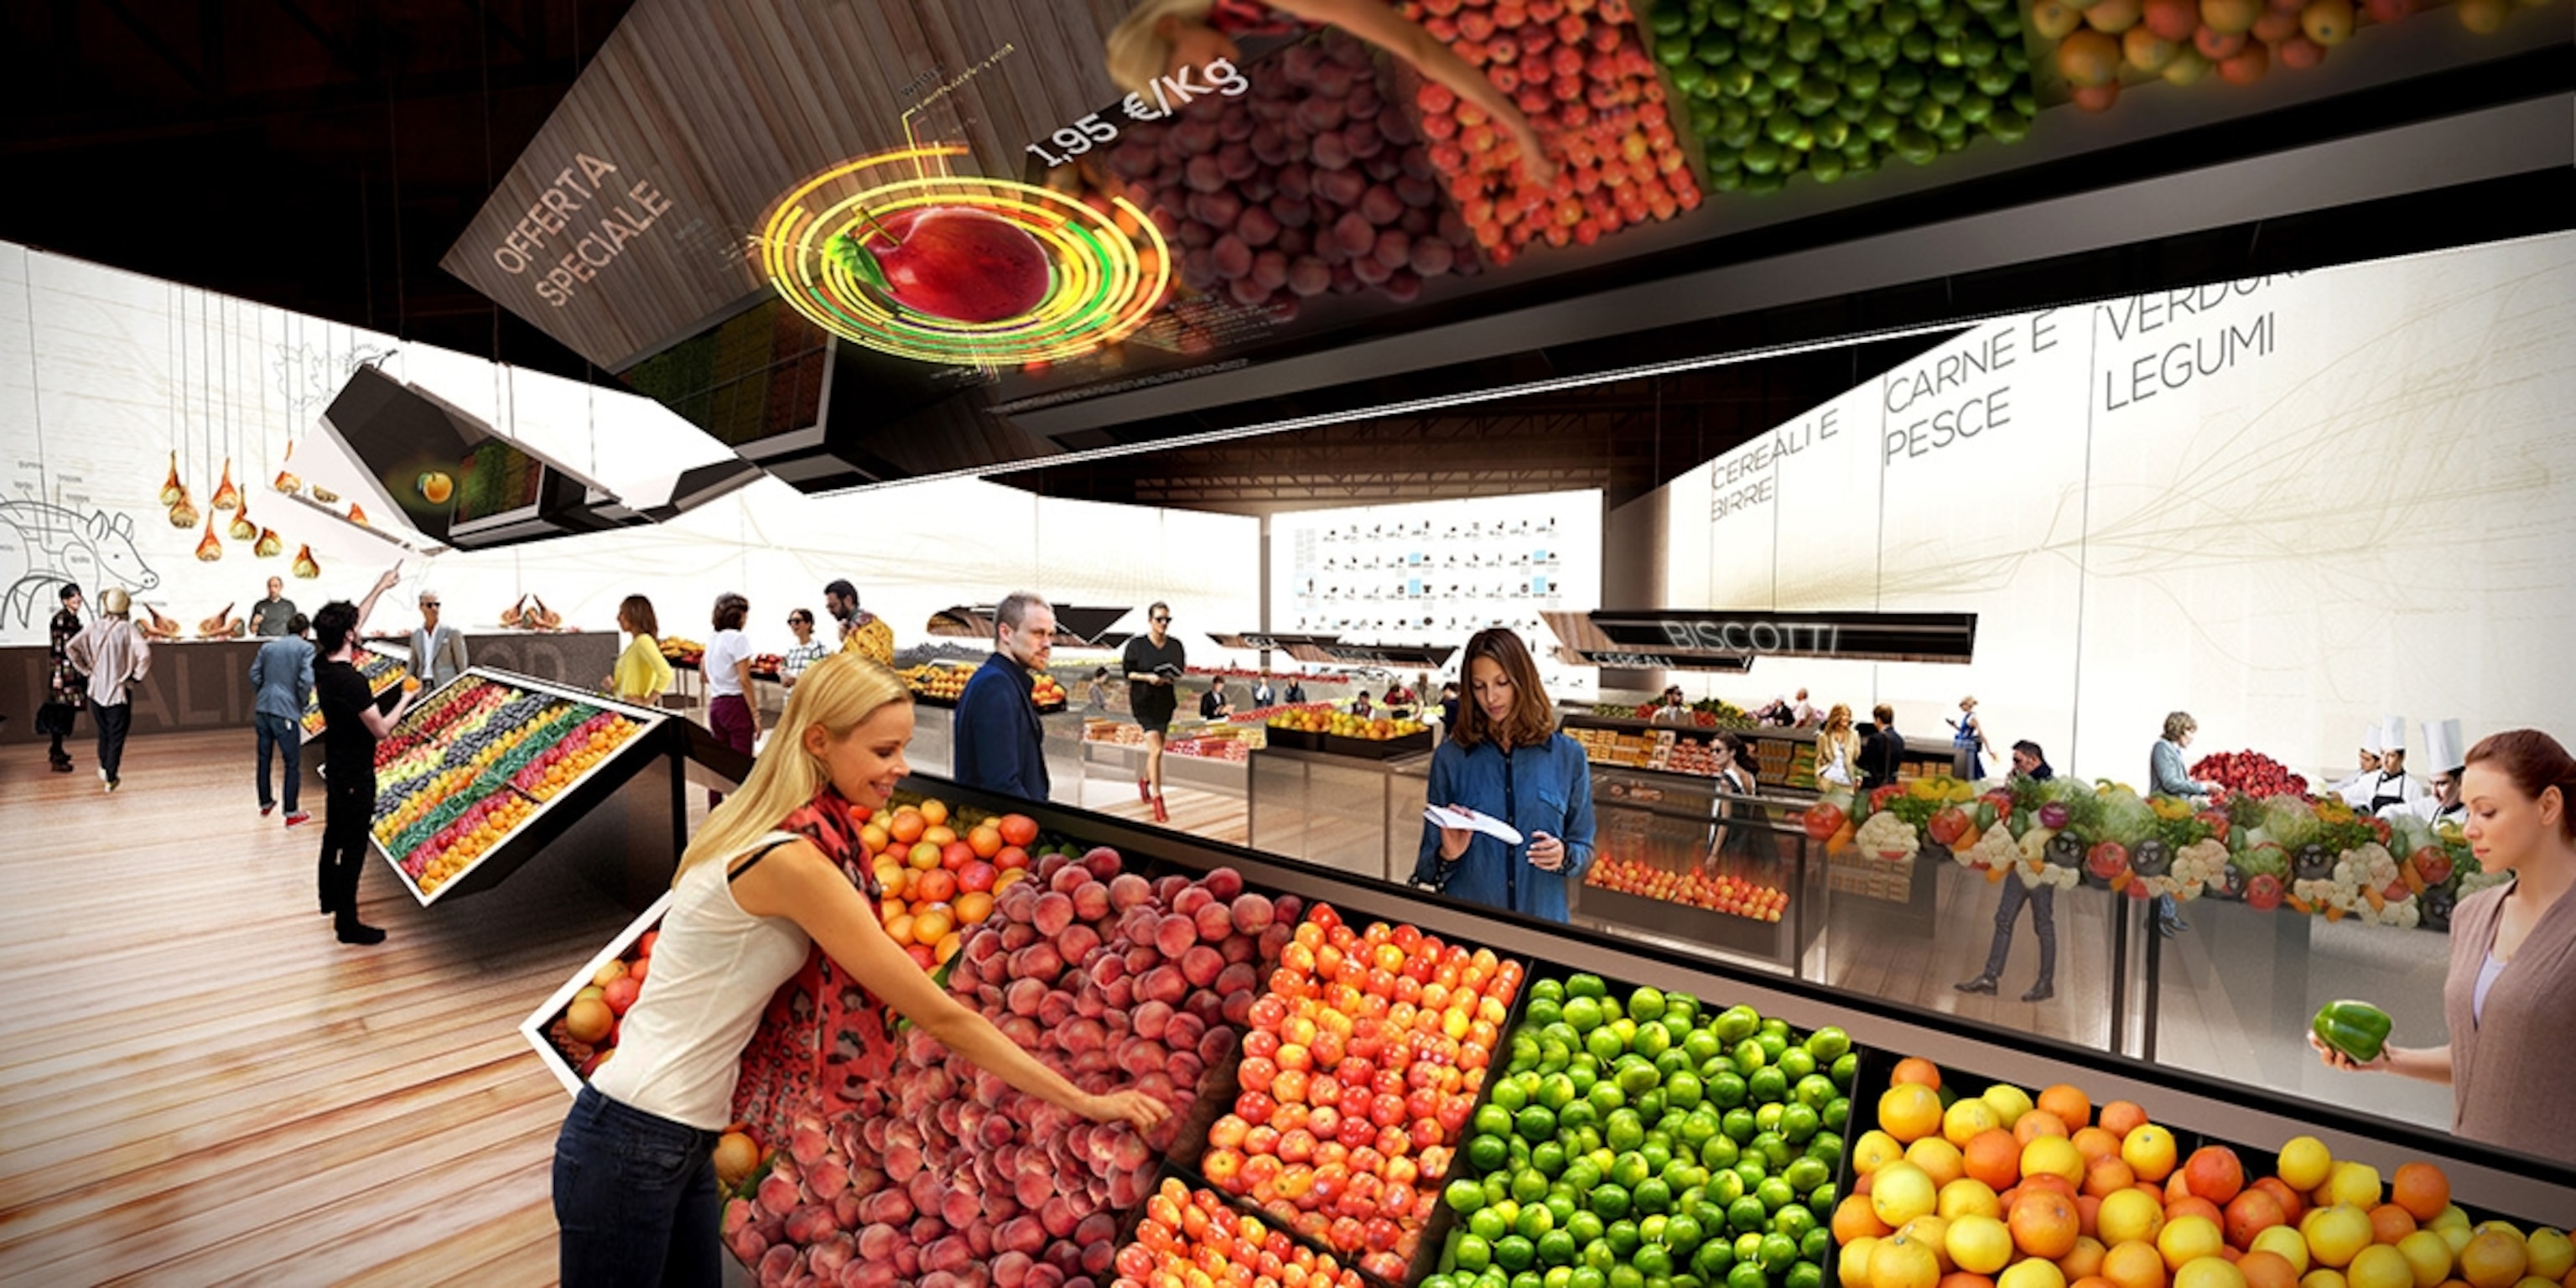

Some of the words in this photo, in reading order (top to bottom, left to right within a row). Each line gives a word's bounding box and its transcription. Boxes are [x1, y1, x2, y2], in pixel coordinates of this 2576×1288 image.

[1026, 112, 1119, 168] 1,95
[1121, 57, 1249, 122] €/Kg
[493, 152, 618, 274] OFFERTA
[535, 179, 673, 307] SPECIALE
[1886, 326, 2016, 413] CARNE
[2031, 306, 2059, 354] E
[2106, 310, 2274, 412] LEGUMI
[1711, 422, 1811, 491] CEREALI
[1820, 407, 1840, 440] E
[1886, 385, 2012, 466] PESCE
[1711, 475, 1774, 523] BIRRE
[1659, 619, 1839, 655] BISCOTTI
